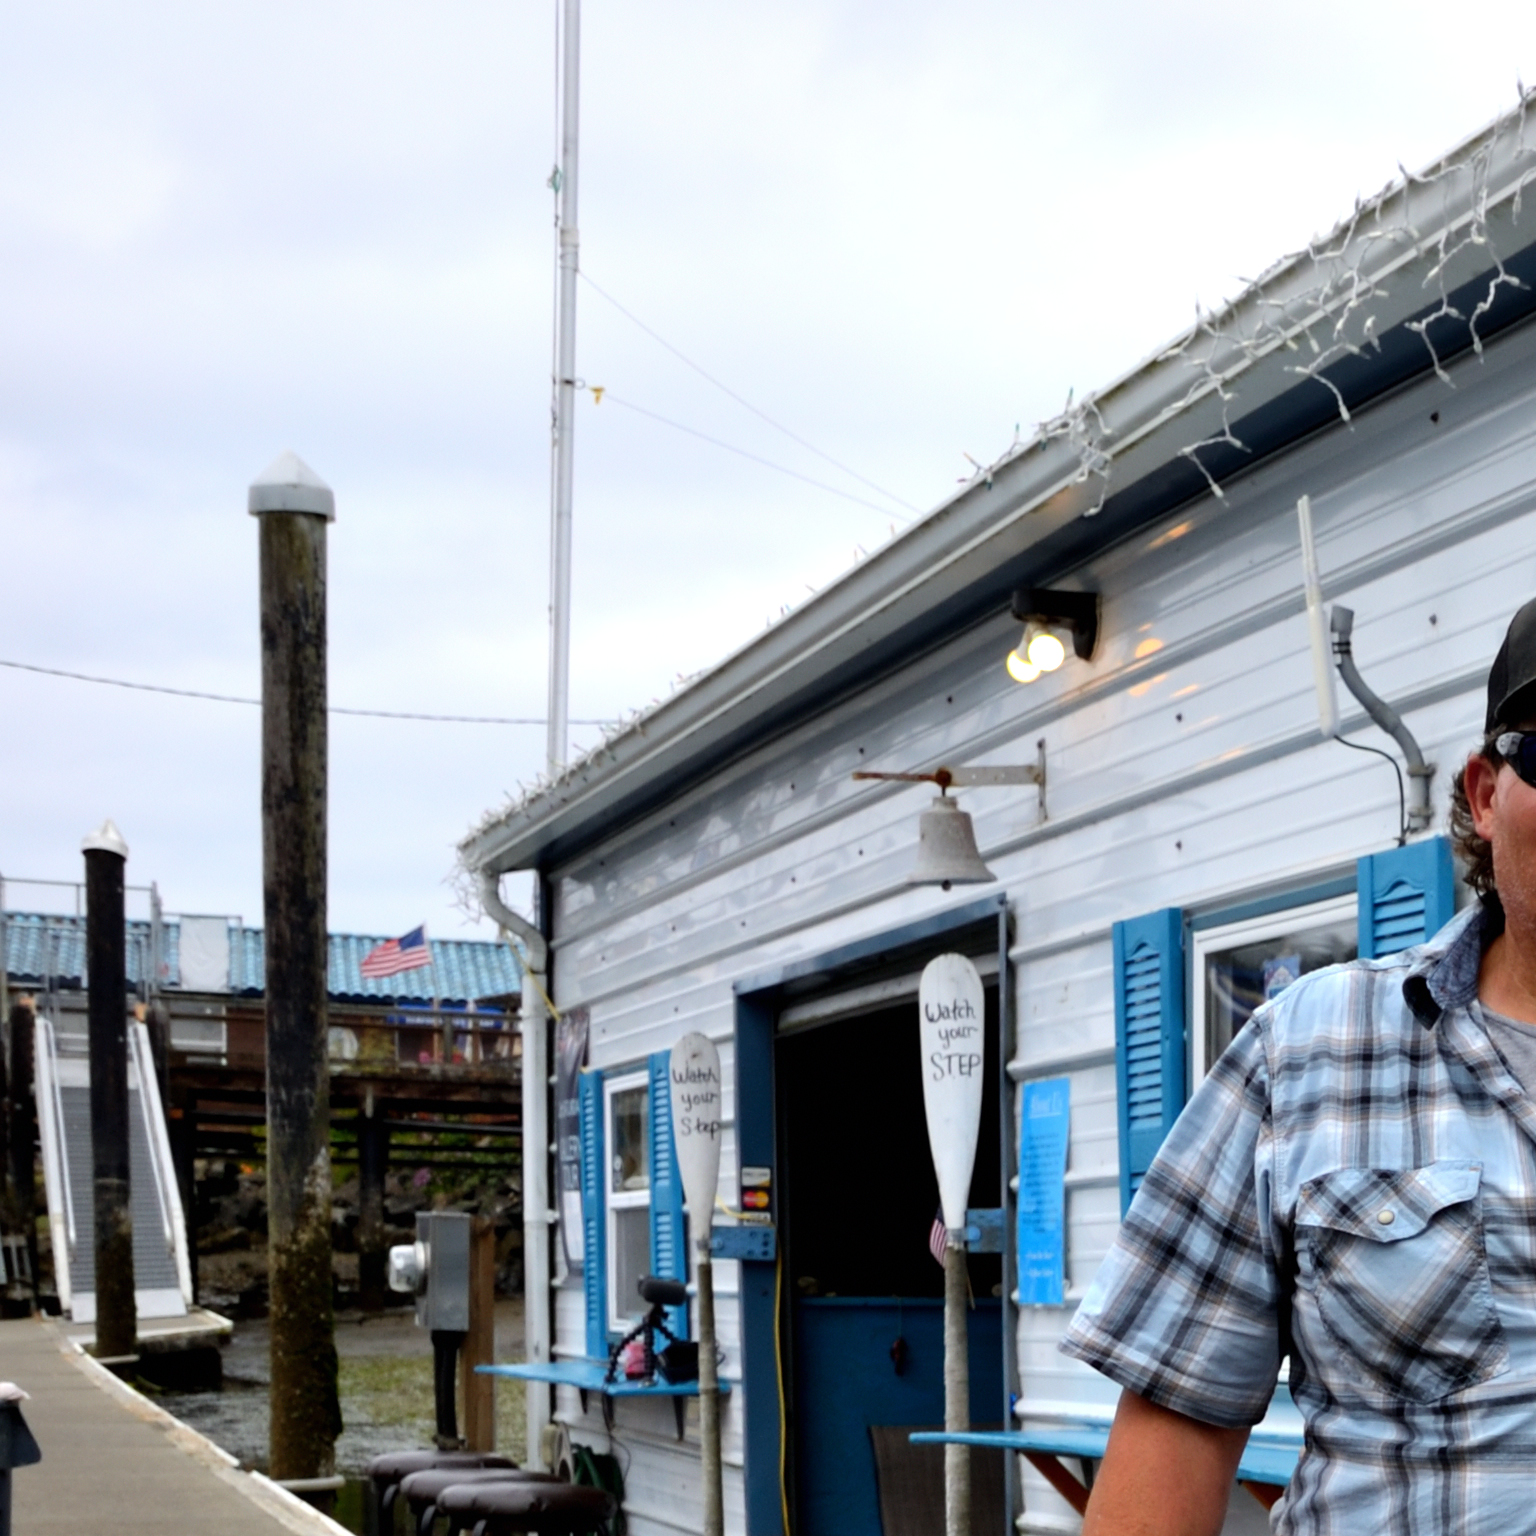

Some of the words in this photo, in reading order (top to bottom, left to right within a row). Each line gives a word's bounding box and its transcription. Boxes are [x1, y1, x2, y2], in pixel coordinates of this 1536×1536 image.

[924, 998, 976, 1023] Watch
[938, 1025, 979, 1050] your
[672, 1062, 719, 1085] Watch
[930, 1052, 981, 1081] STEP
[681, 1091, 720, 1112] your
[680, 1117, 721, 1140] Step
